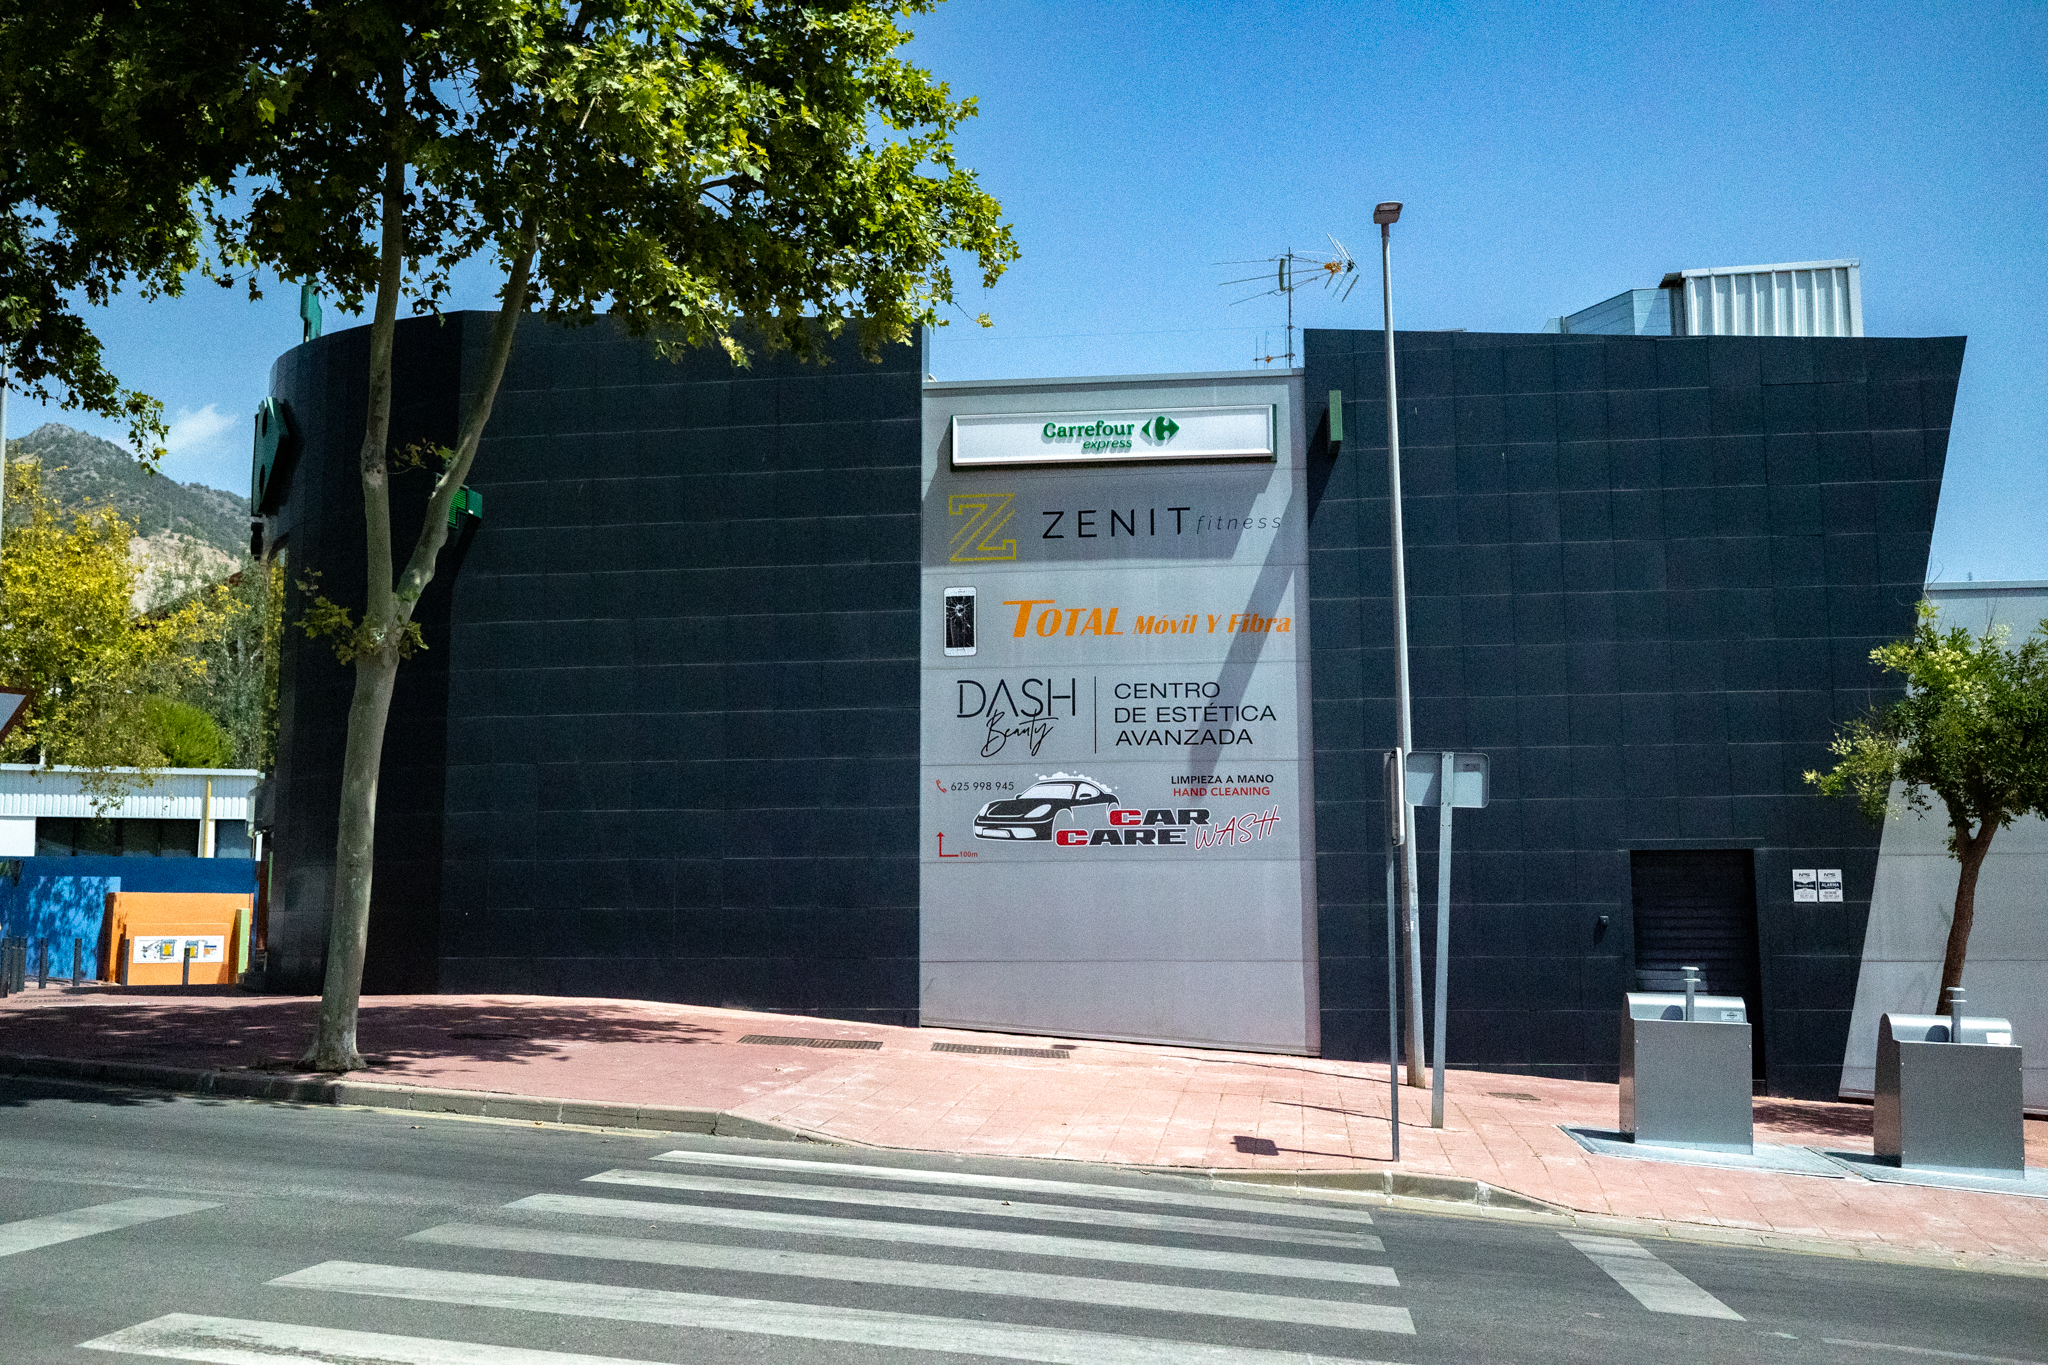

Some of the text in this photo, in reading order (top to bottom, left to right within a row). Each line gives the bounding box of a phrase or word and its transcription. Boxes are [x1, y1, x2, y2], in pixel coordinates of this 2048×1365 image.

[1043, 420, 1135, 438] Carrefour
[1083, 439, 1132, 451] express
[1042, 507, 1282, 539] ZENIT fitness
[1133, 614, 1198, 635] Móvil
[1207, 614, 1222, 633] Y
[1227, 613, 1291, 634] Fibra
[957, 678, 1076, 718] DASH
[1114, 682, 1221, 700] CENTRO
[1114, 702, 1277, 723] DE ESTÉTICA
[980, 708, 1059, 758] Beauty
[1115, 729, 1253, 746] AVANZADA
[950, 781, 1014, 791] 625 998 945
[1171, 774, 1274, 785] LIMPIEZA A MANO
[1173, 786, 1270, 797] HAND CLEANING
[1109, 809, 1211, 826] CAR
[1195, 805, 1280, 850] WASH
[1055, 829, 1187, 846] CARE
